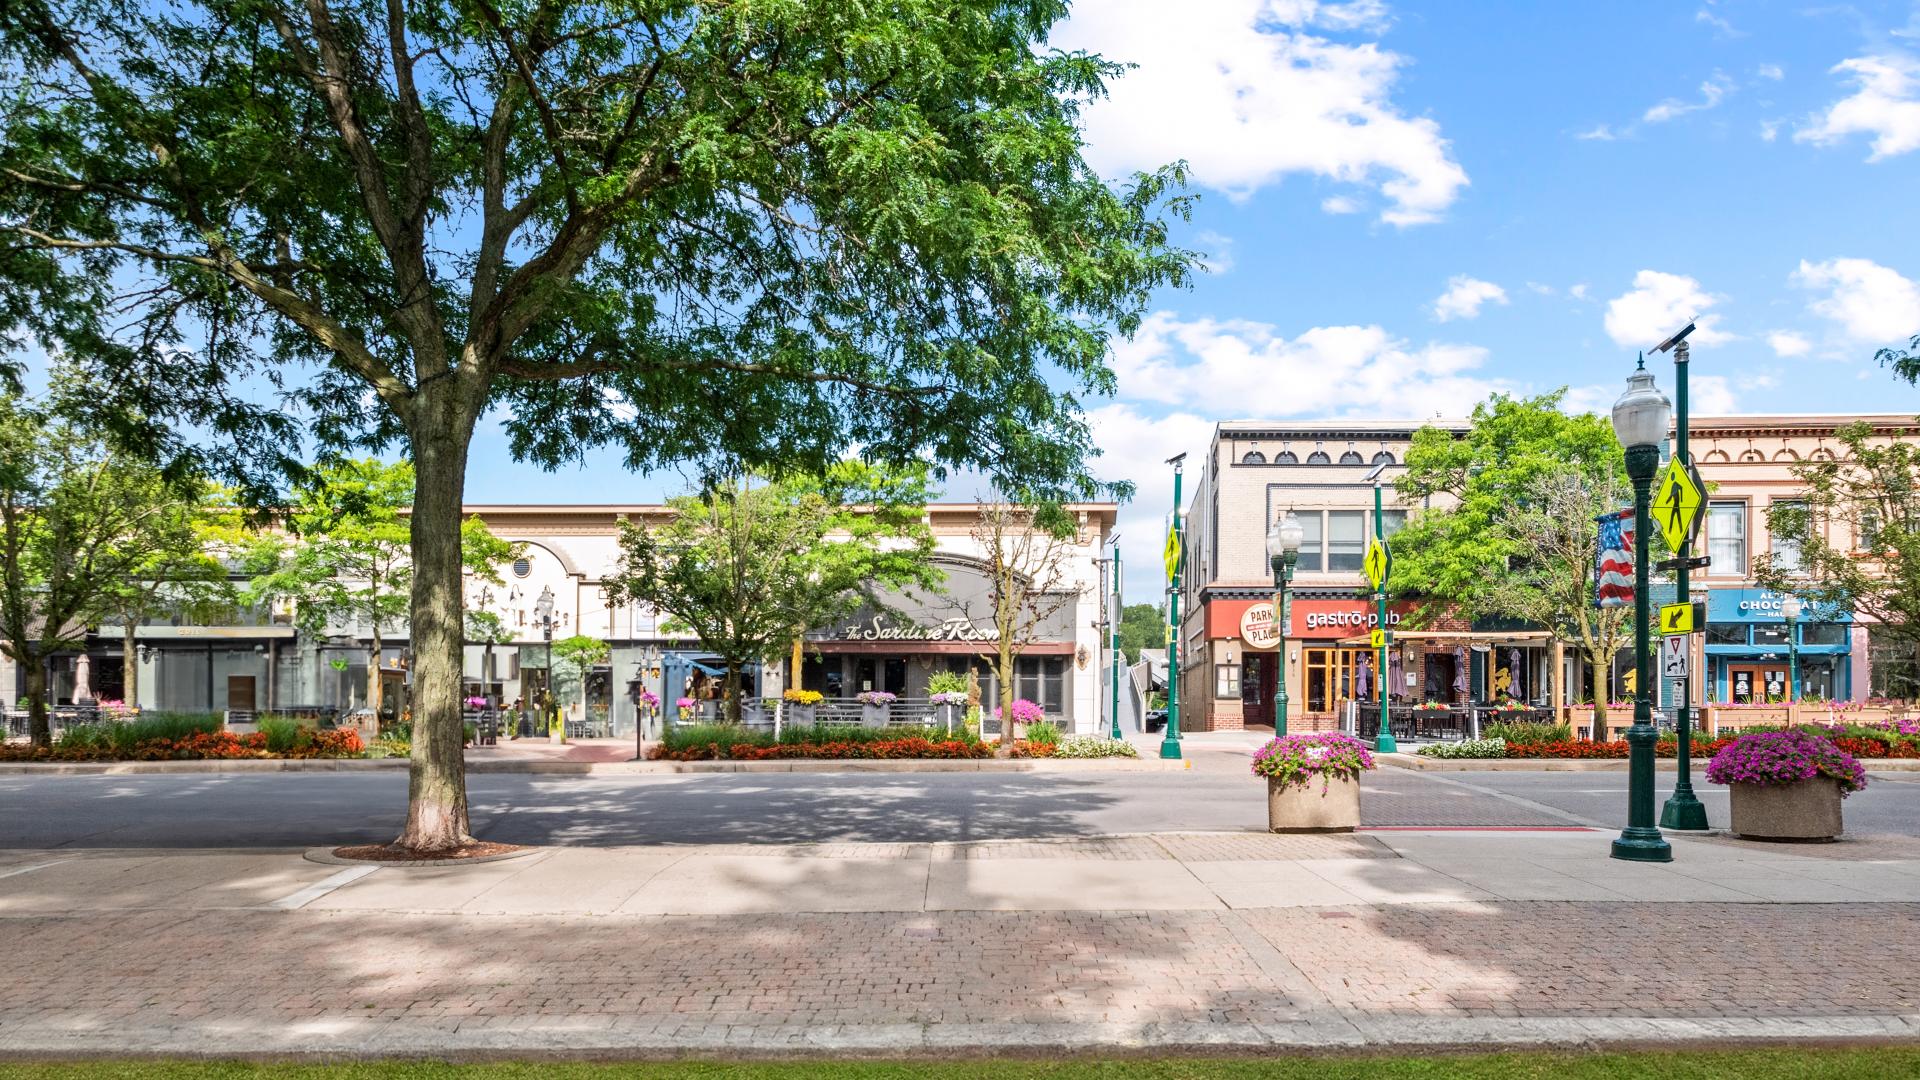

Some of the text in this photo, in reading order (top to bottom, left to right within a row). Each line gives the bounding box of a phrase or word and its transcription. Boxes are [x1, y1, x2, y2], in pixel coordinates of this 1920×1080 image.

[1740, 601, 1818, 610] CHOCAT
[1250, 609, 1273, 622] PARK
[846, 624, 861, 640] The
[1252, 629, 1274, 642] PLAC
